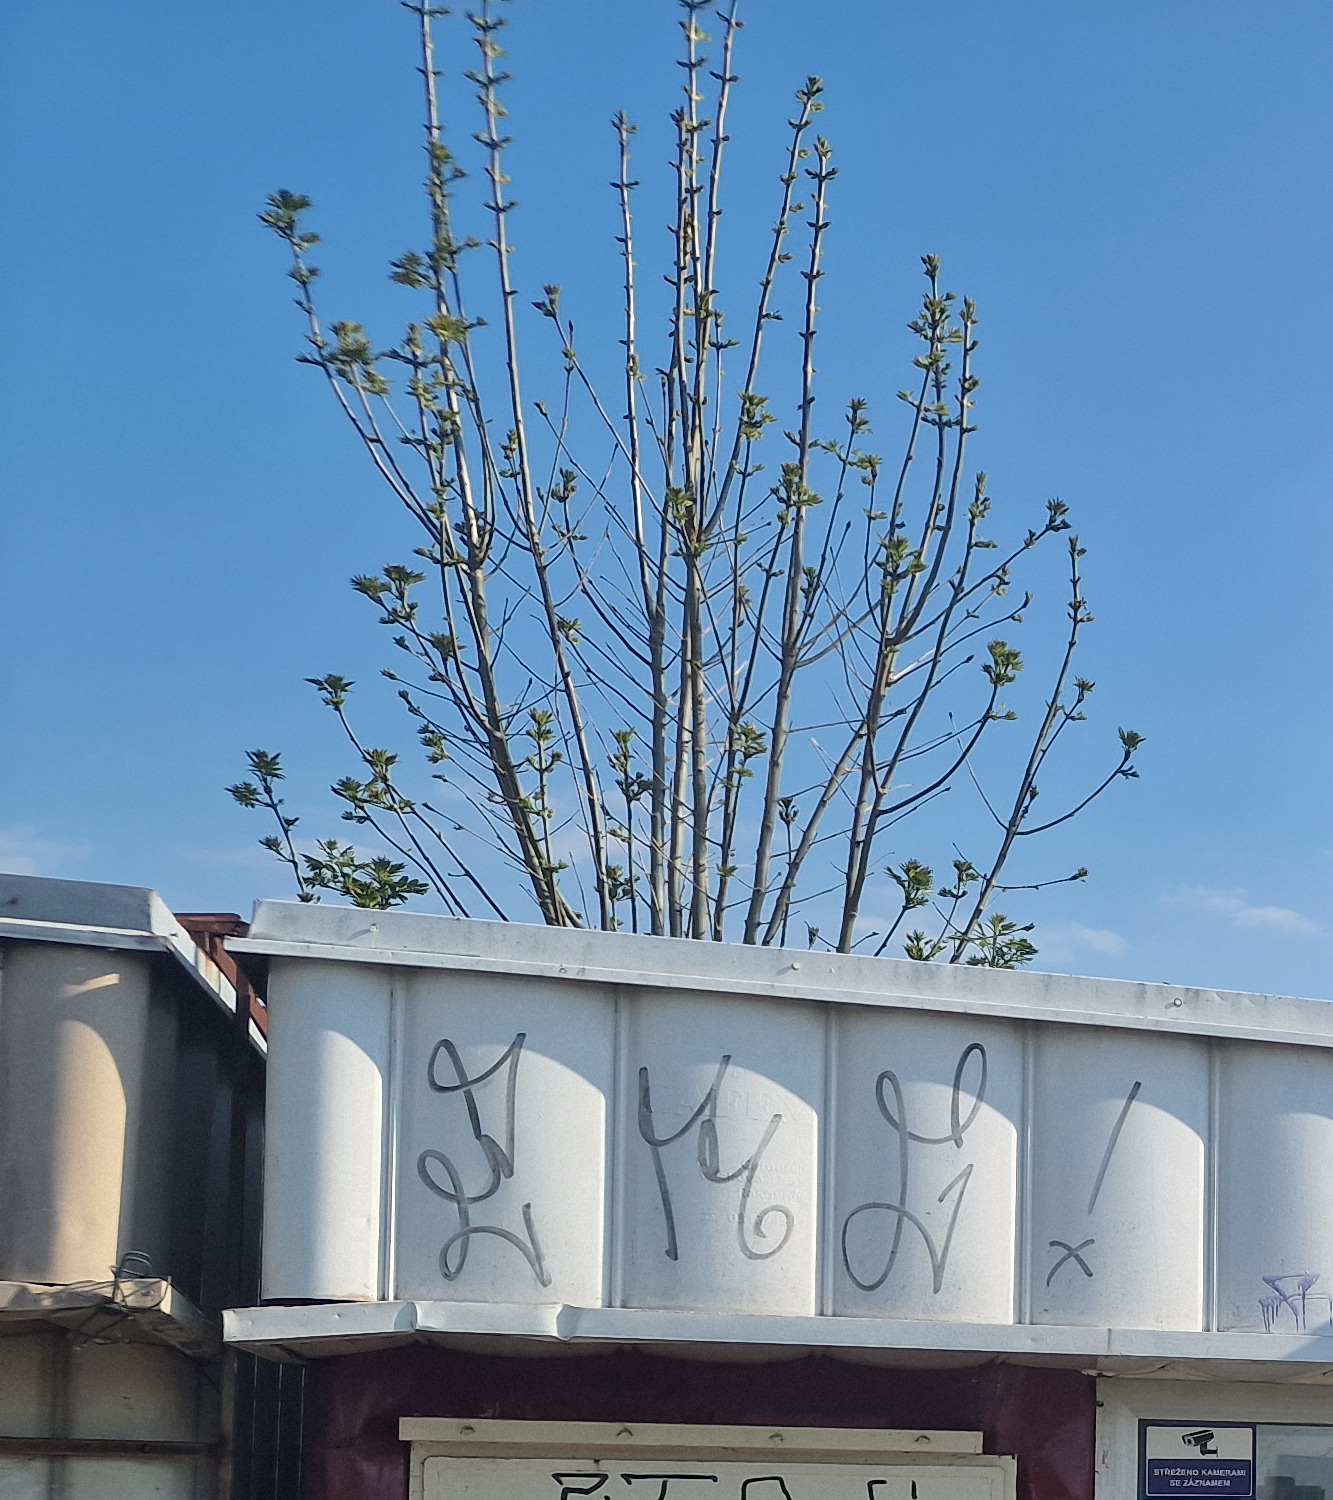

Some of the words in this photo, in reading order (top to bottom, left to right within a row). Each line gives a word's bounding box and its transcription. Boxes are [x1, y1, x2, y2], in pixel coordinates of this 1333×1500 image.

[1154, 1467, 1199, 1476] STŘEŽENO
[1201, 1468, 1246, 1476] KAMERAMI
[1183, 1477, 1230, 1486] ZÁZNAMEM
